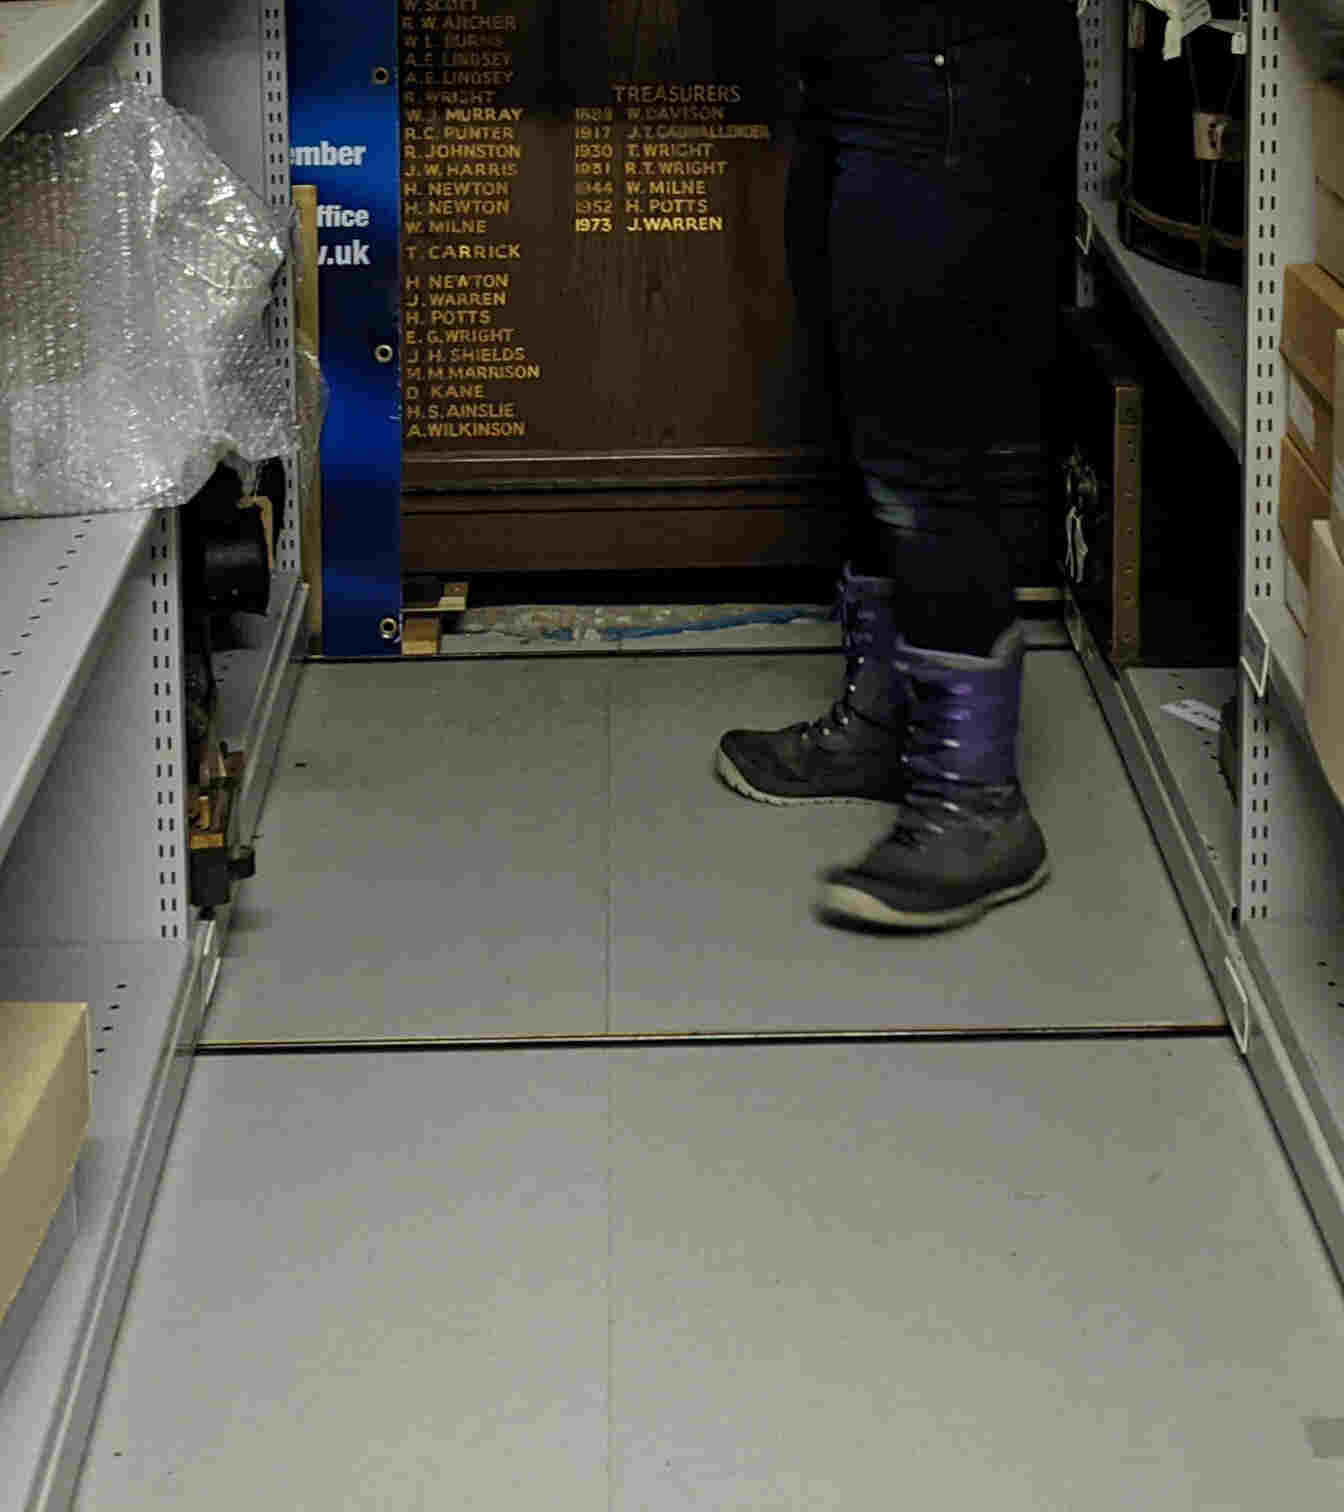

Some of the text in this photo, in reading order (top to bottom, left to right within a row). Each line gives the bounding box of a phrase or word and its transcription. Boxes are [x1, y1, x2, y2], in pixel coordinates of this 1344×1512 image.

[612, 82, 743, 104] TREASURERS
[443, 108, 524, 123] MURRAY
[443, 127, 515, 141] PUNTER
[575, 125, 611, 140] 1917
[424, 144, 522, 159] JOHNSTON
[446, 164, 520, 177] HARRIS
[427, 181, 510, 197] NEWTON
[648, 180, 706, 195] MILNE
[427, 199, 511, 216] NEWTON
[648, 199, 709, 214] POTTS
[428, 219, 488, 234] MILNE
[575, 216, 612, 233] 1973
[427, 244, 521, 260] CARRICK
[428, 273, 510, 290] NEWTON
[429, 291, 507, 307] WARREN
[431, 310, 492, 326] POTTS
[449, 346, 527, 364] SHIELDS
[430, 384, 486, 400] KANE
